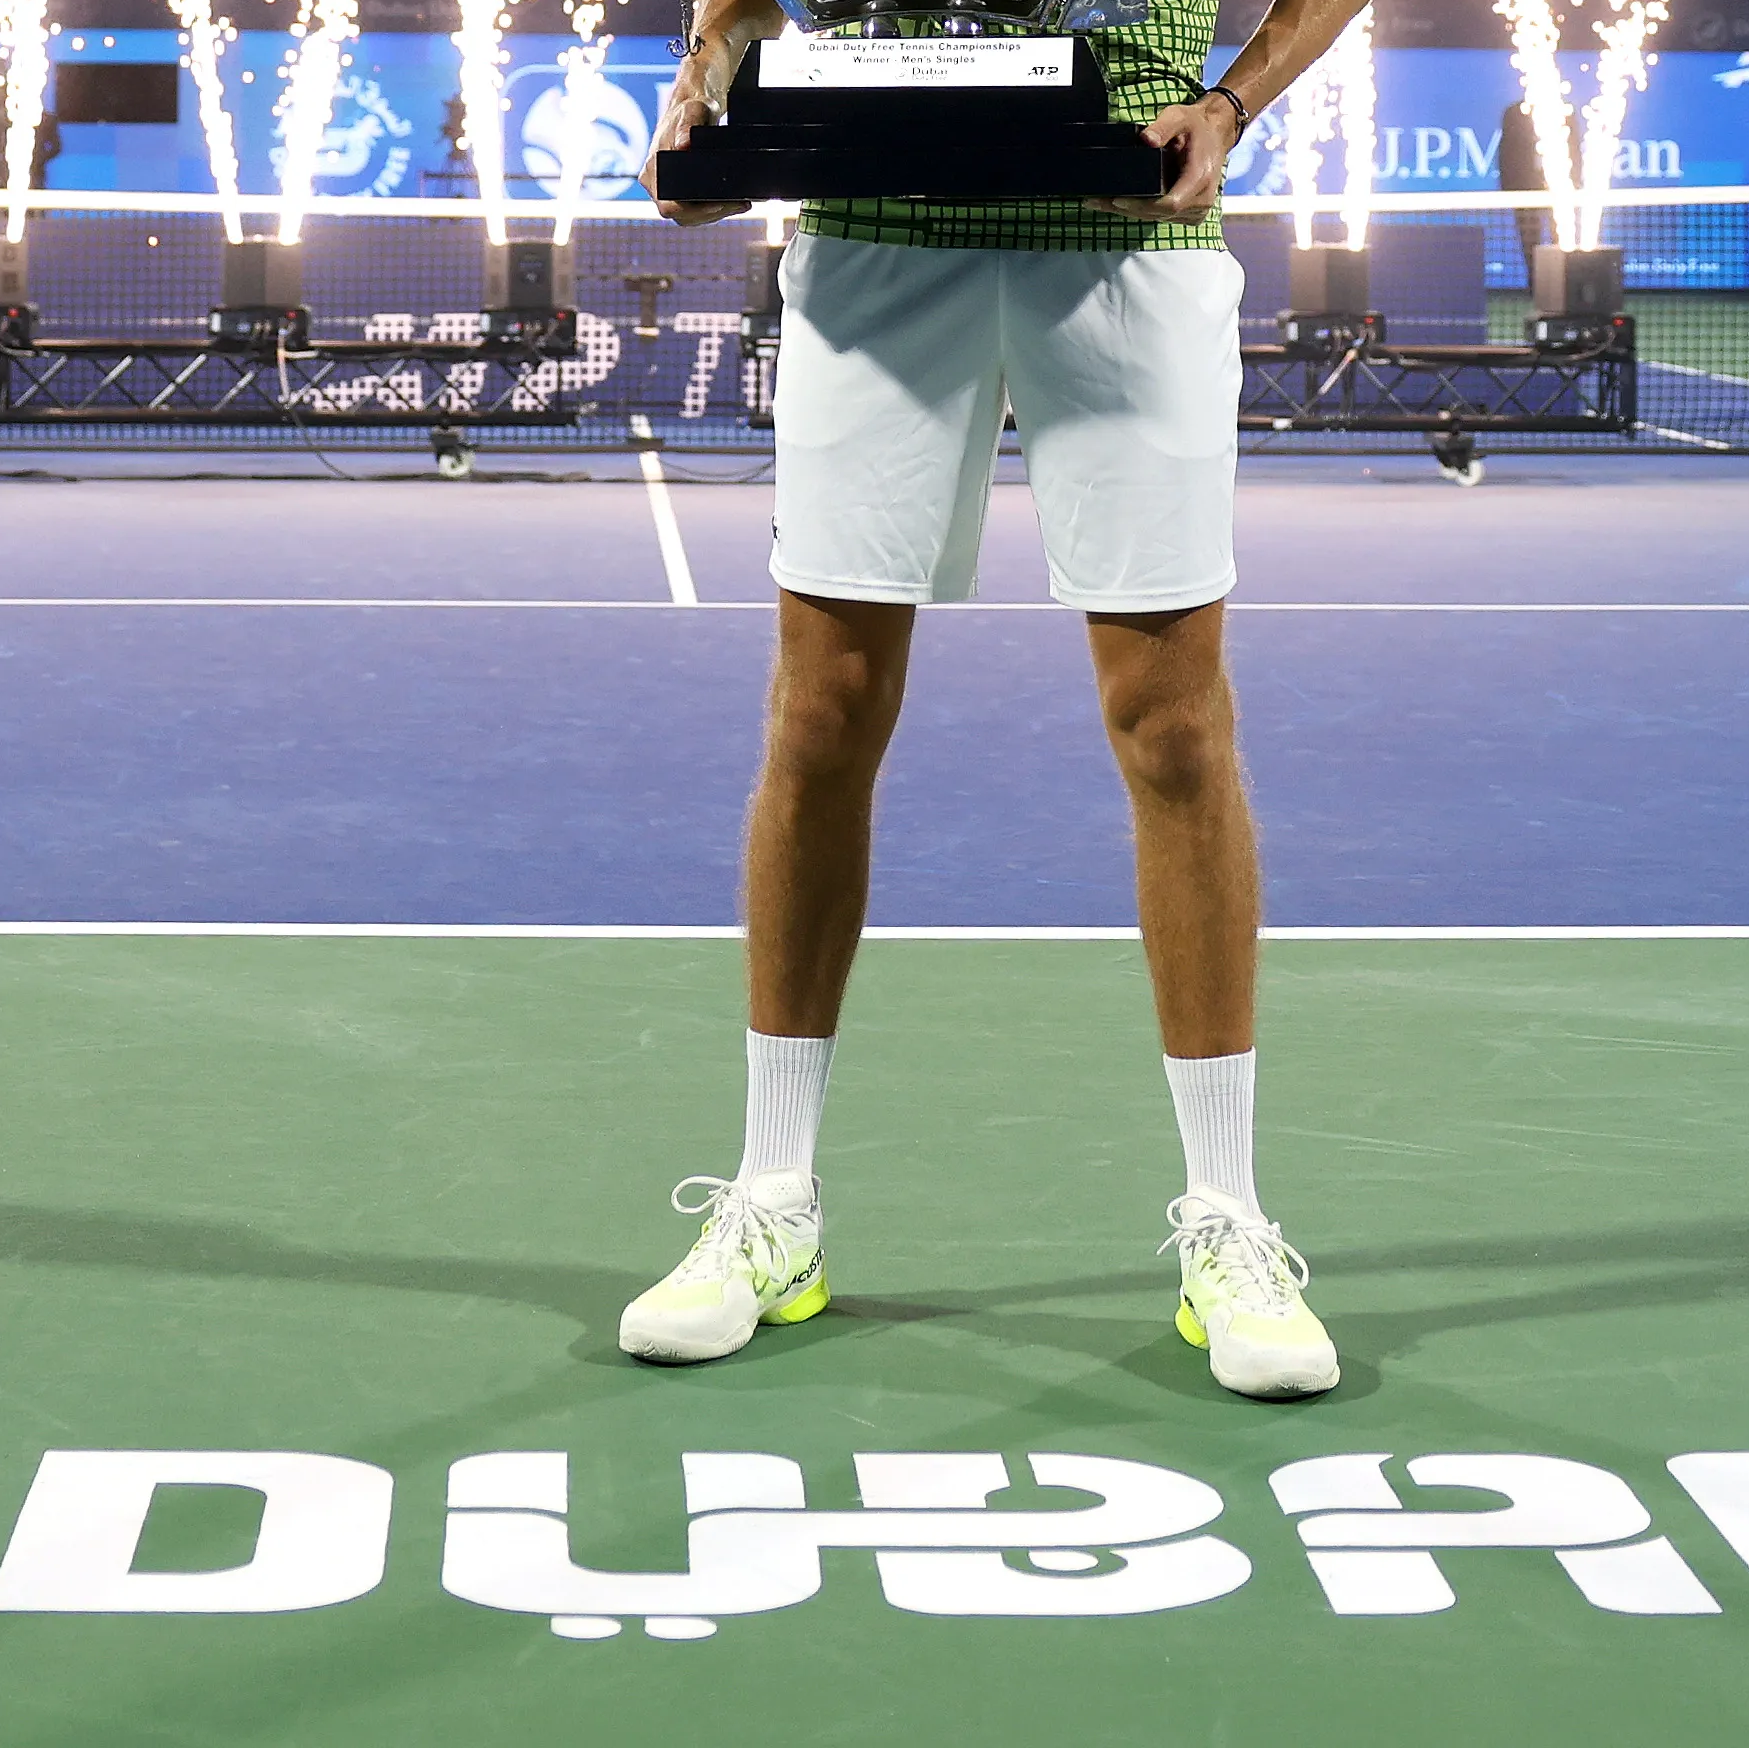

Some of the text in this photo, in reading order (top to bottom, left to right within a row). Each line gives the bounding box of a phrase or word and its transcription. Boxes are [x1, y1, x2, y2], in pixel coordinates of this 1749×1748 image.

[808, 42, 1021, 53] Dubai Duty Free Tennis Championships
[853, 55, 976, 66] Winner Men's Singles
